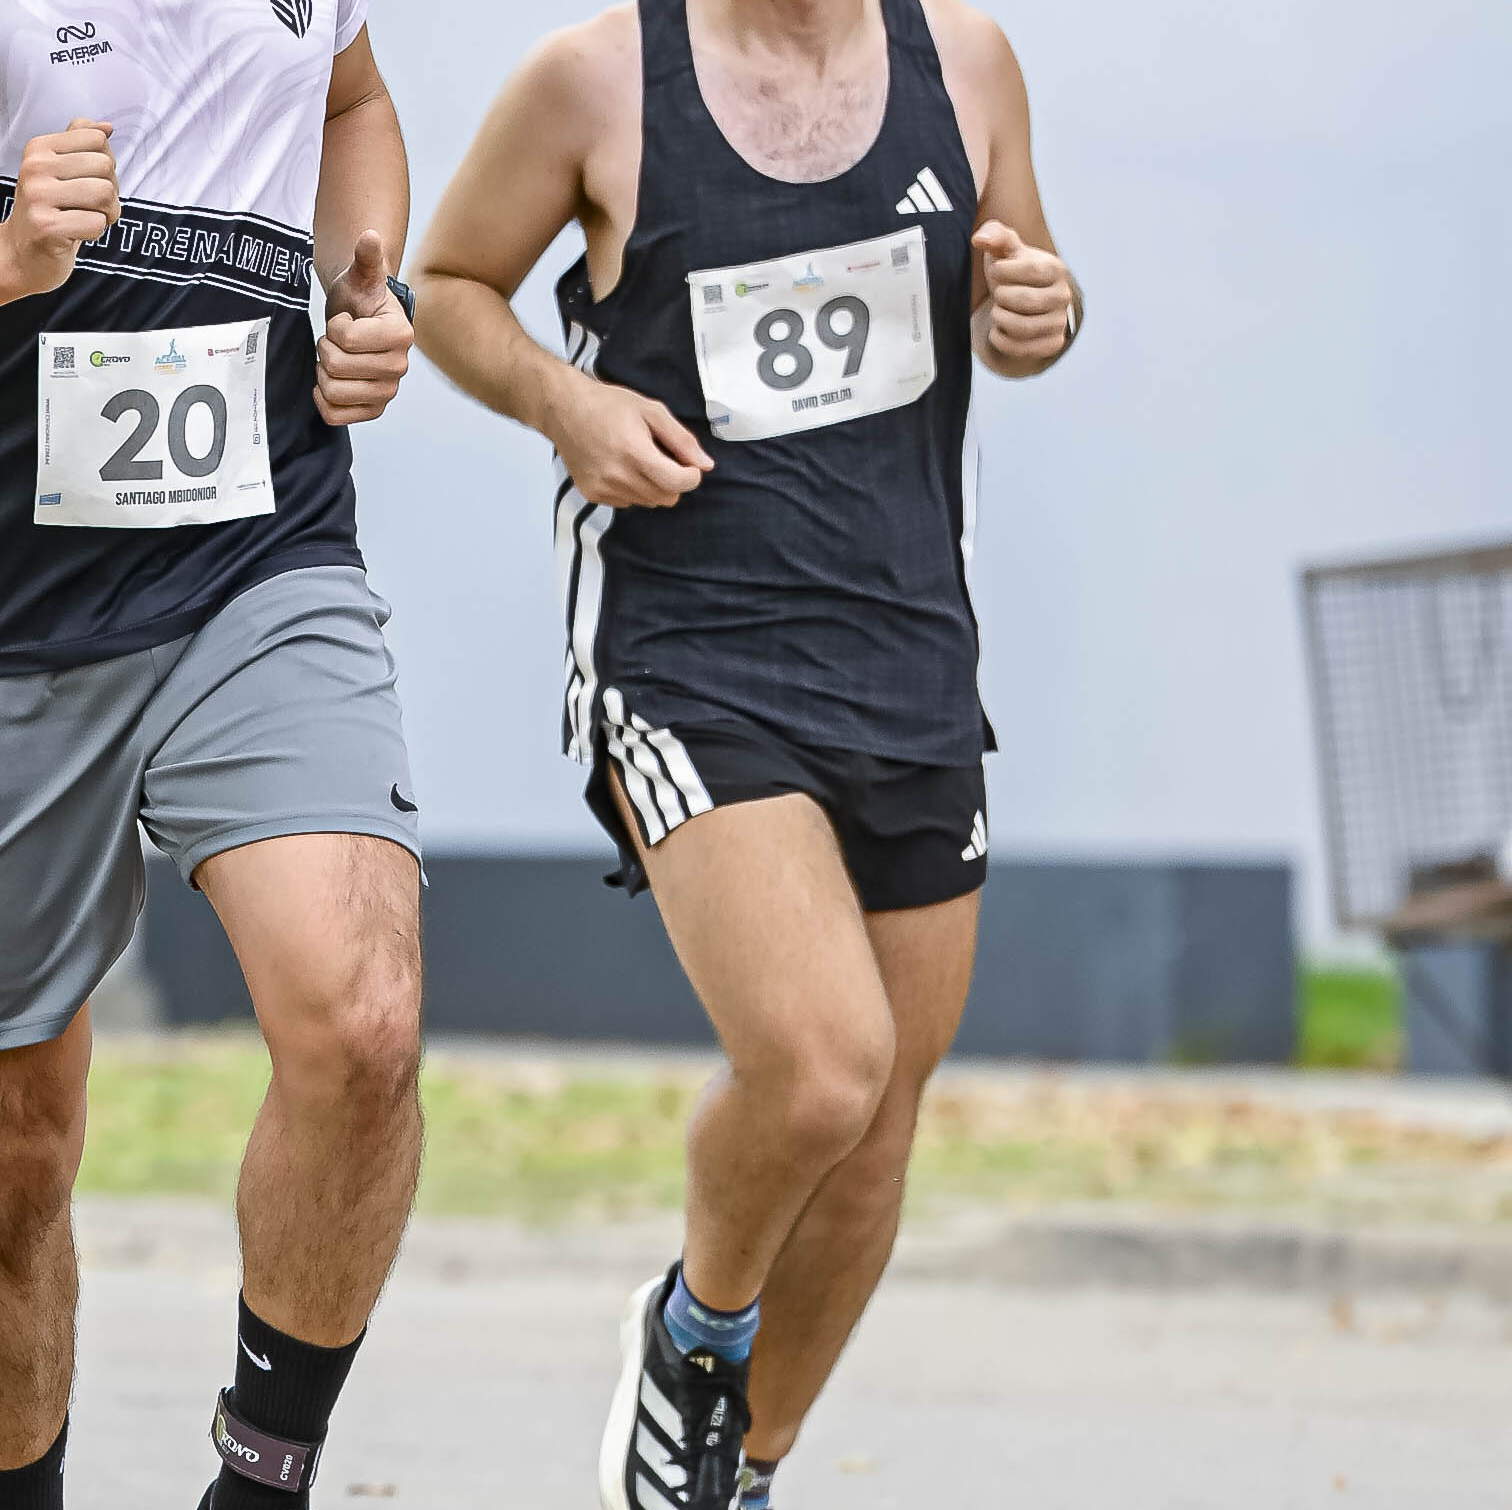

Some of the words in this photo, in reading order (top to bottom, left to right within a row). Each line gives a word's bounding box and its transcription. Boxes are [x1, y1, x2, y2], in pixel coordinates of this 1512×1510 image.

[753, 295, 870, 391] 89
[98, 384, 228, 481] 20
[115, 490, 166, 505] SANTIAGO
[168, 486, 217, 503] MBIDONIOR
